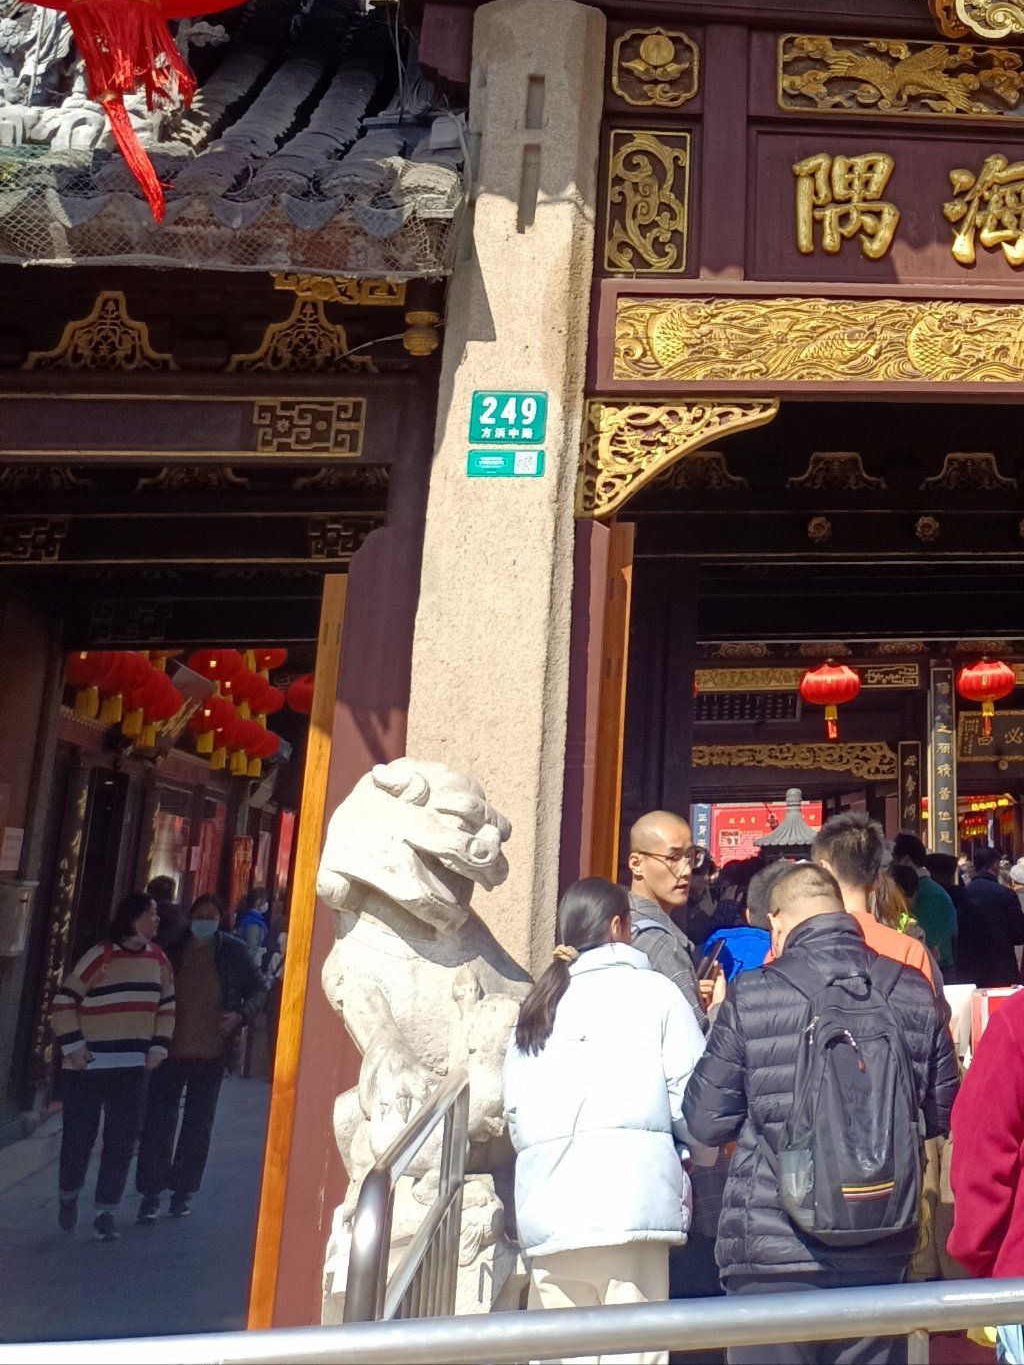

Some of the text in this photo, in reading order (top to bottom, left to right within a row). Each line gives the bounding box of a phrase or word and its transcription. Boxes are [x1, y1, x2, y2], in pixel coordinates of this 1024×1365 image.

[479, 396, 537, 425] 249
[481, 427, 533, 439] 方浜中路
